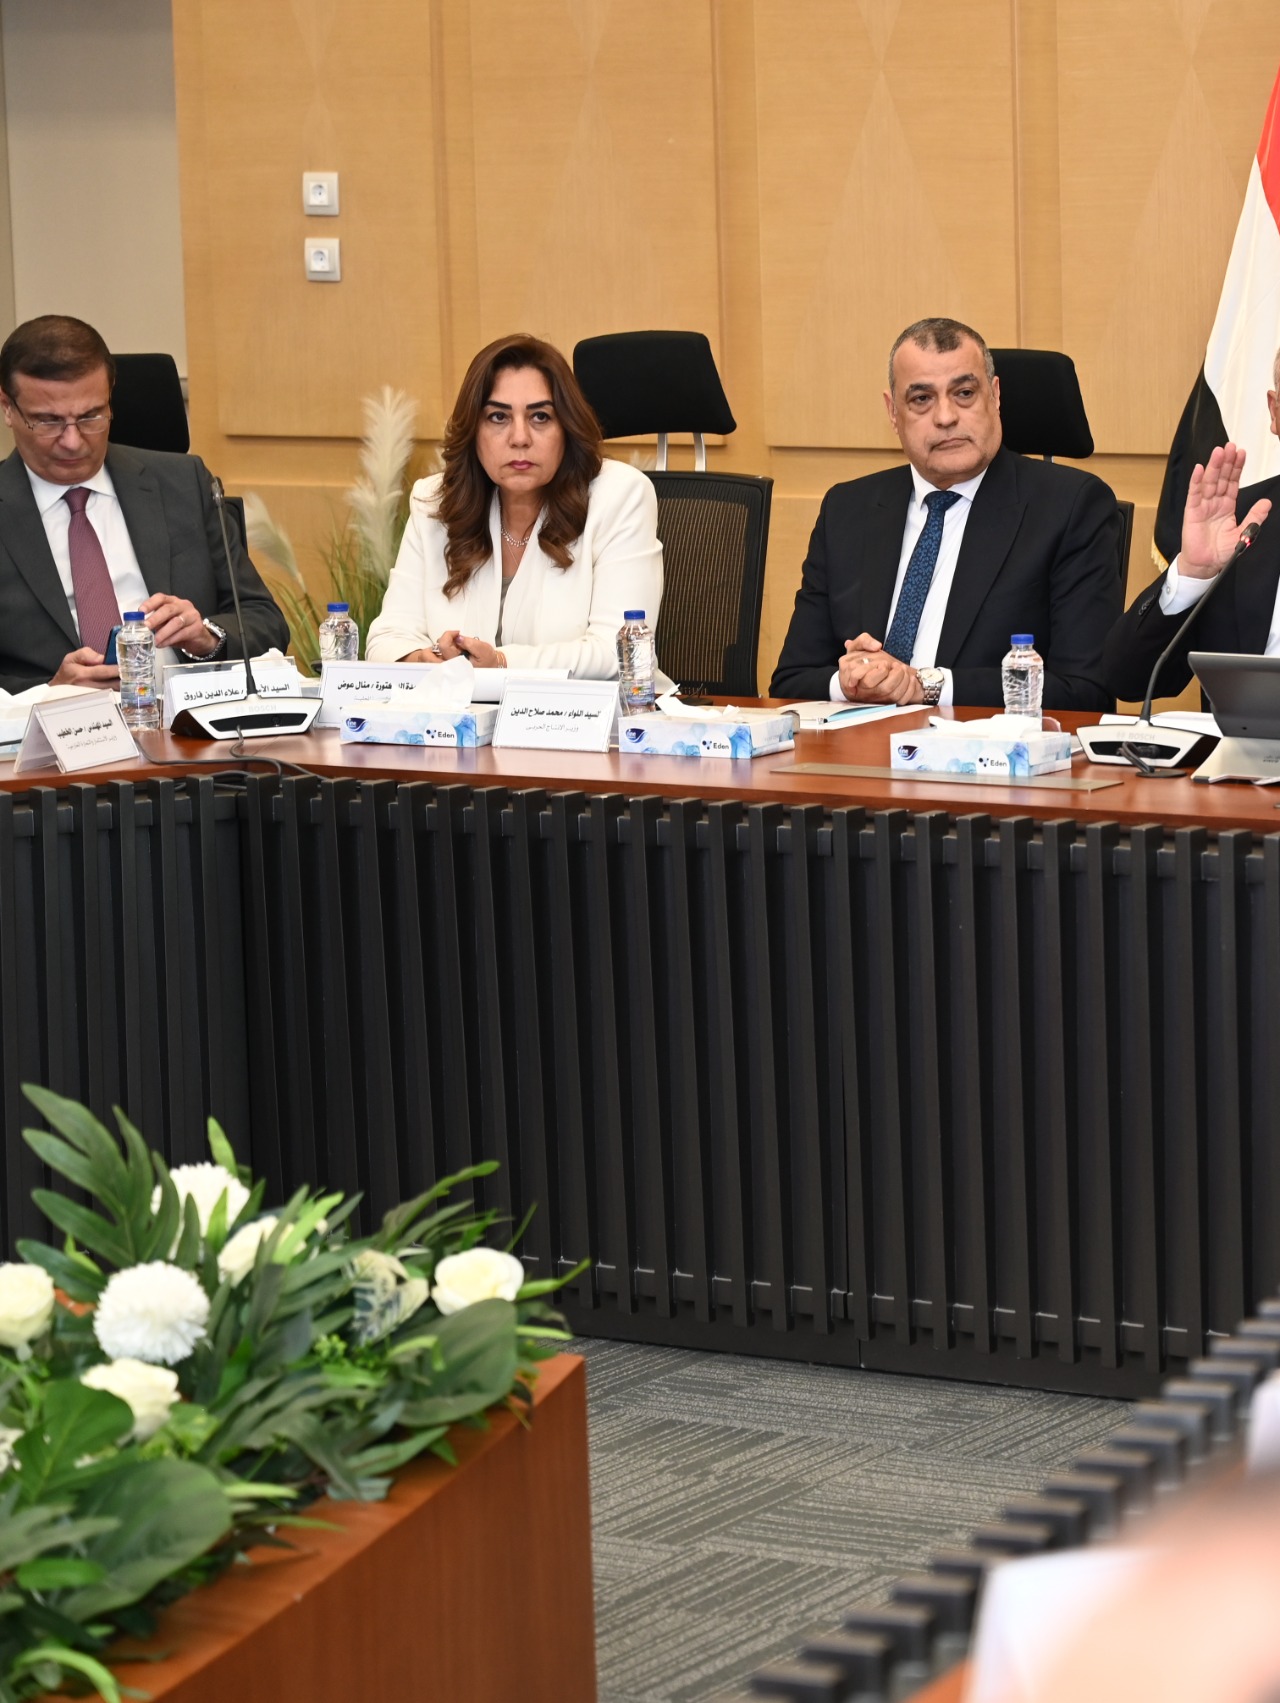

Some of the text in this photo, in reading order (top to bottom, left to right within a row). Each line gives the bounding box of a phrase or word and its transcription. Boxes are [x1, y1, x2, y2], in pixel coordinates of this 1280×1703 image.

[270, 683, 290, 693] السيد
[337, 680, 354, 690] عوض
[355, 680, 371, 690] منال
[183, 691, 203, 701] فاروق
[204, 688, 223, 699] الدين
[224, 687, 240, 697] علاء
[510, 707, 528, 717] الدين
[528, 707, 545, 717] صلاح
[546, 709, 563, 717] محمد
[568, 709, 584, 719] اللواء
[585, 710, 602, 720] السيد
[437, 731, 455, 739] Eden
[1128, 732, 1156, 741] BOSCH
[713, 742, 729, 750] Eden
[990, 759, 1007, 767] Eden
